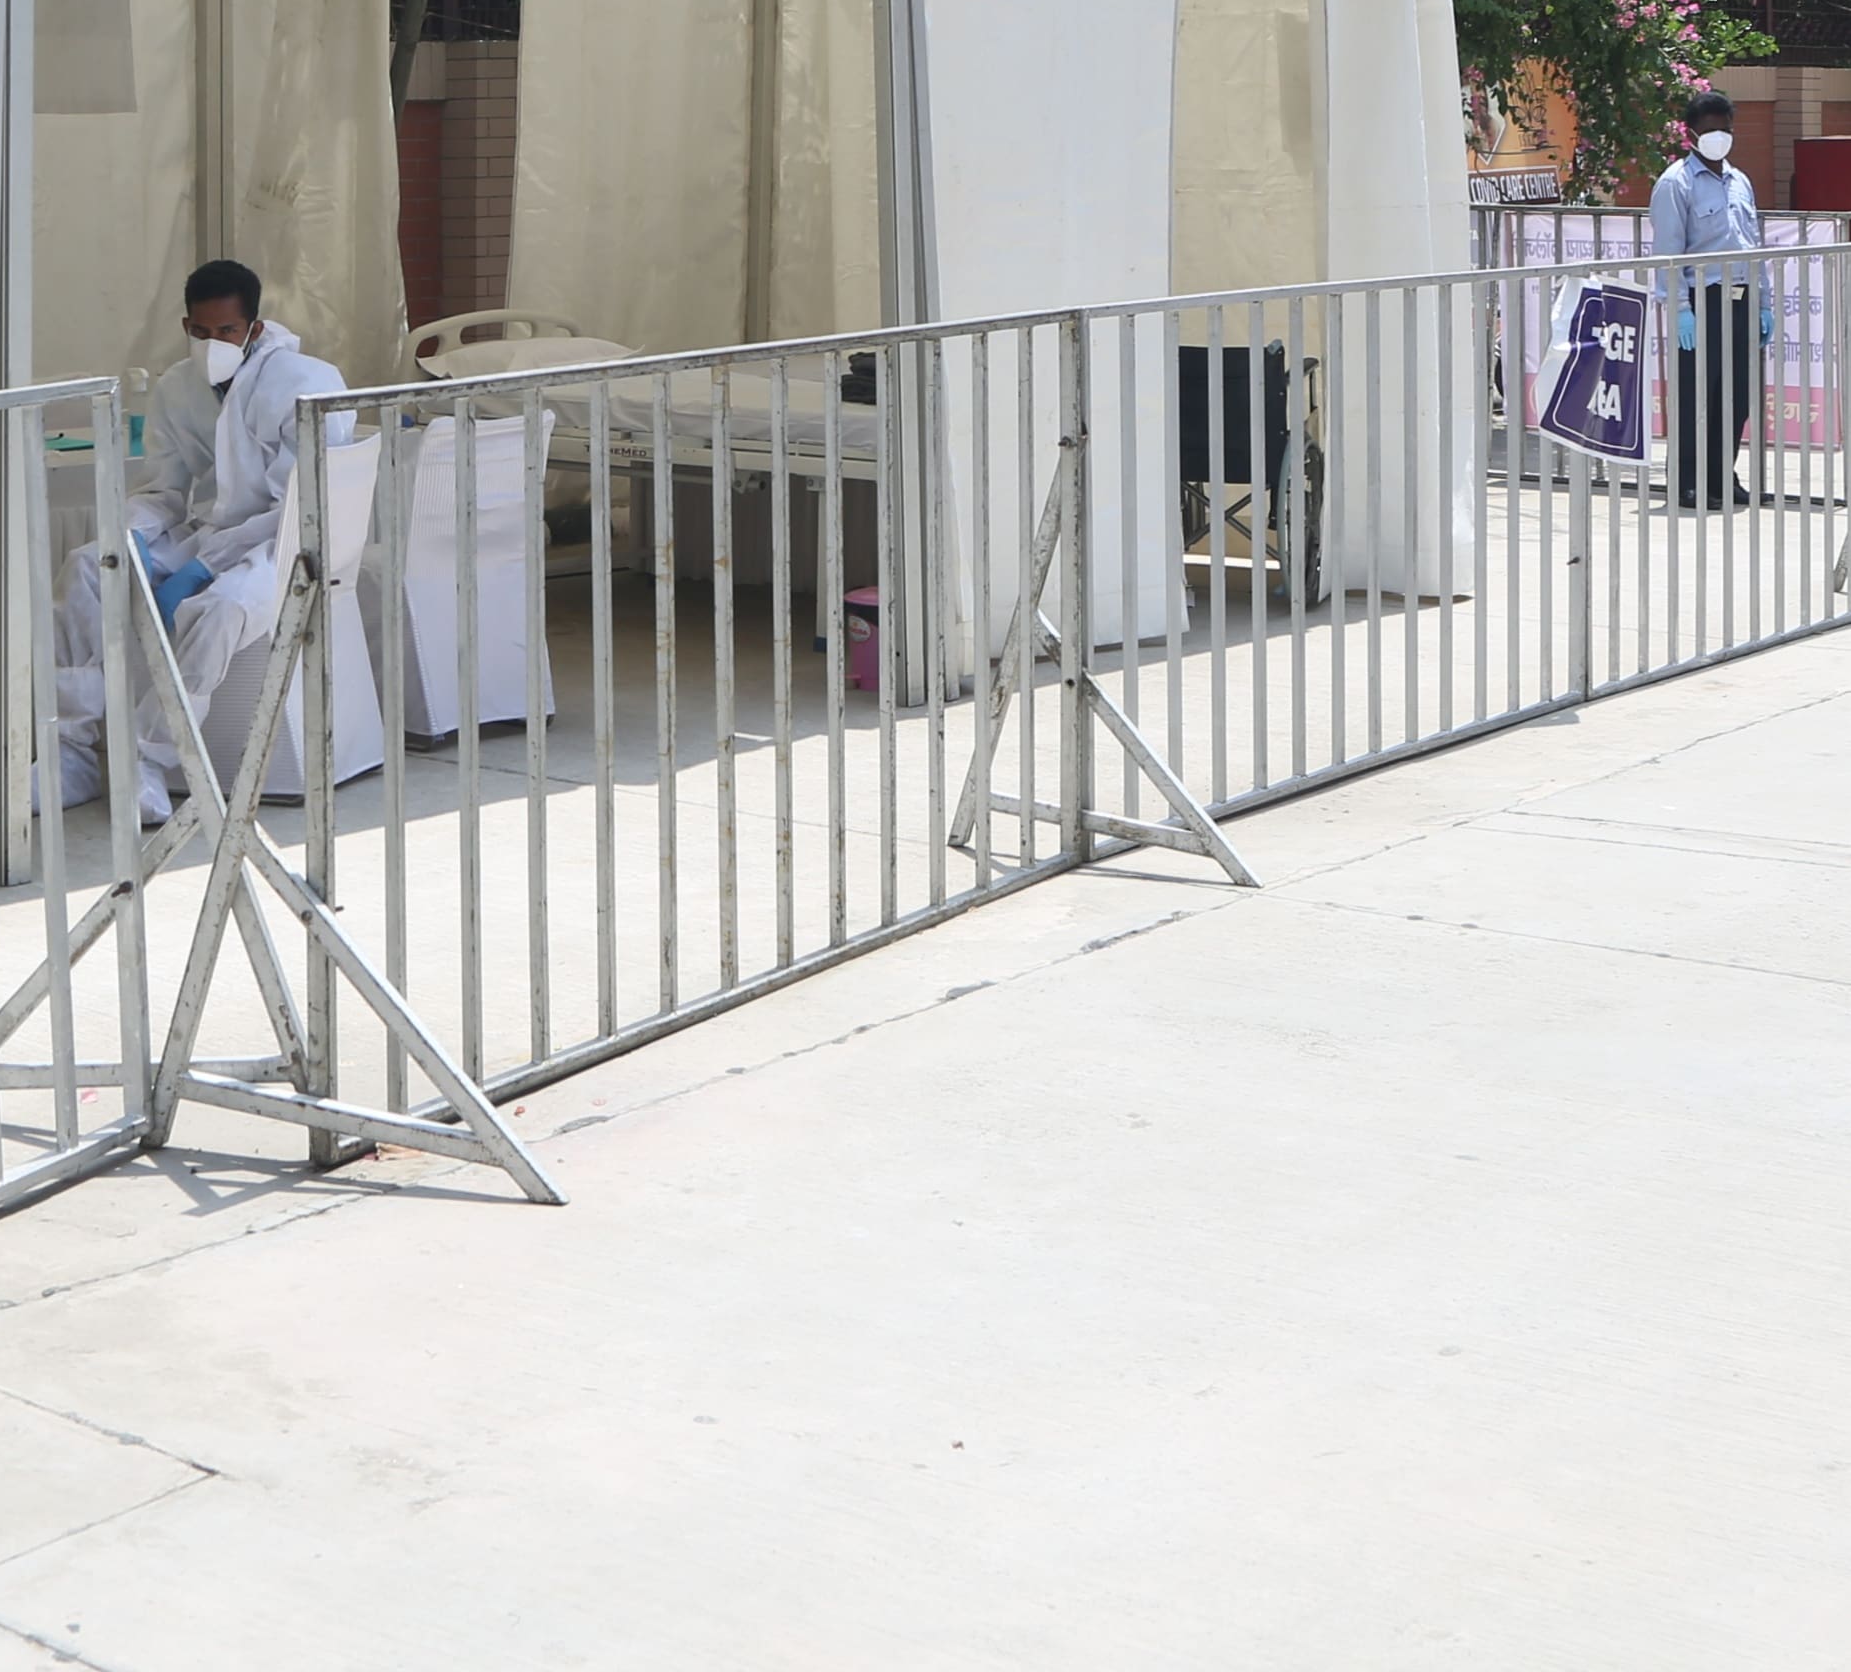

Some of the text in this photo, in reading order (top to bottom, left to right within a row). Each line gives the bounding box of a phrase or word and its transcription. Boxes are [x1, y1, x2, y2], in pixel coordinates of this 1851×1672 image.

[1470, 172, 1558, 204] COVID CARE CENTRE
